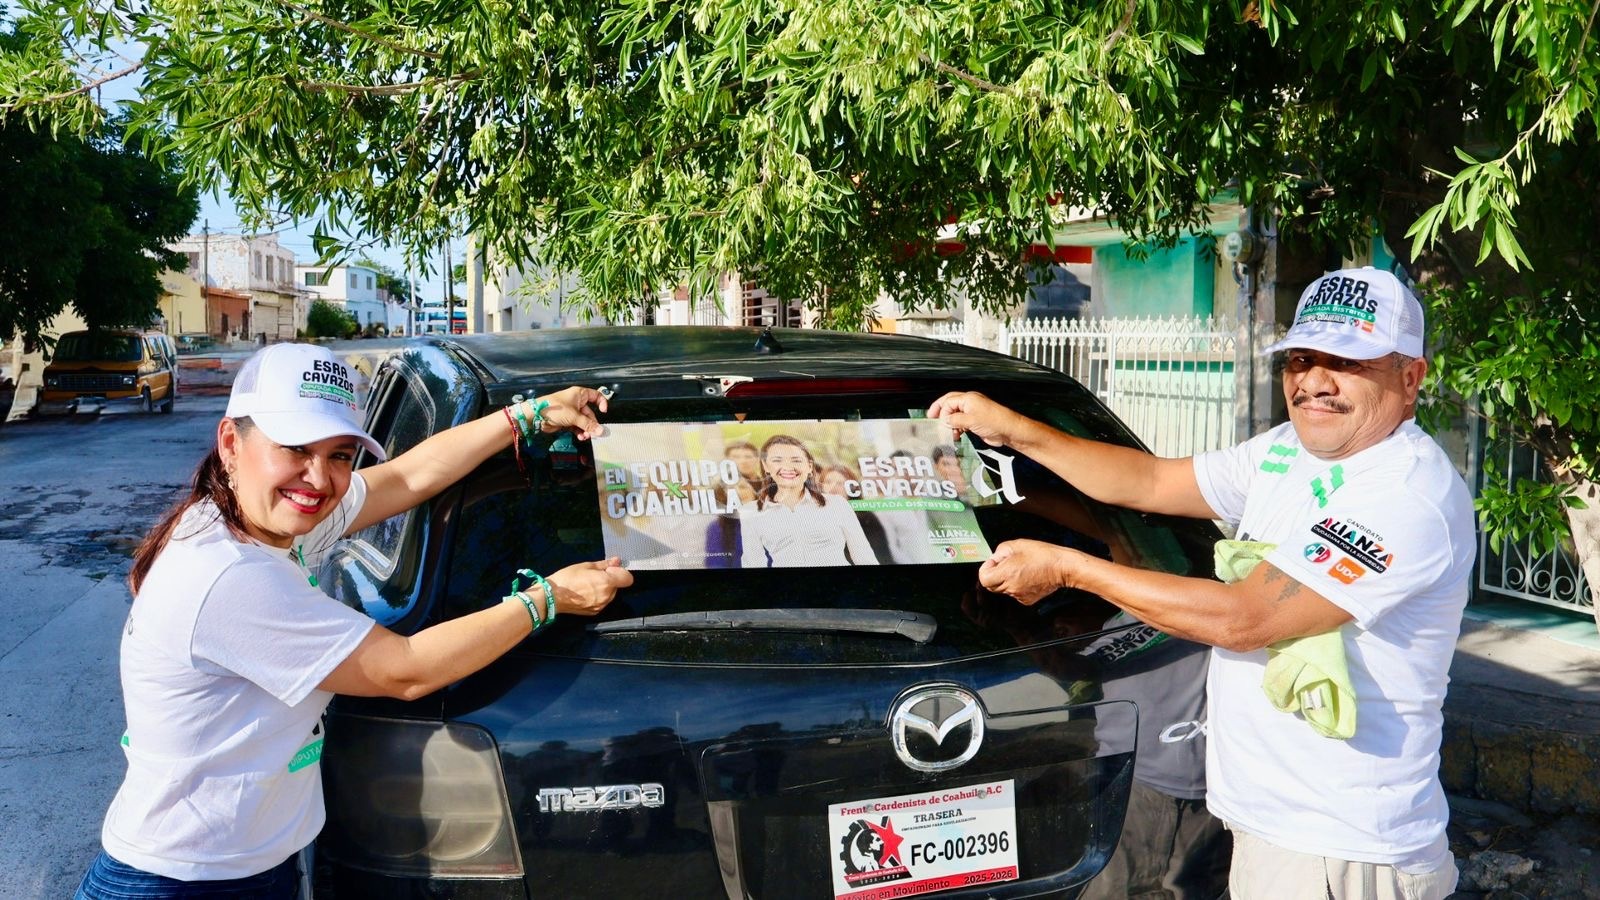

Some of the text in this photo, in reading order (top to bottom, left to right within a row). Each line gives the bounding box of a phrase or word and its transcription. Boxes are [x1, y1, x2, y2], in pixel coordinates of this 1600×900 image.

[1318, 276, 1370, 297] ESRA
[1304, 292, 1378, 314] CAVAZOS
[313, 360, 348, 379] ESRA
[303, 371, 354, 394] CAVAZOS
[605, 459, 741, 490] EN EQUIPO
[858, 455, 935, 478] ESRA
[844, 478, 959, 499] CAVAZOS
[607, 488, 743, 519] COAHUILA
[852, 500, 903, 510] DIPUTADA
[905, 500, 950, 510] DISTRITO
[928, 529, 978, 538] ALIANZA
[1346, 518, 1384, 542] CANDIDATO
[1313, 525, 1384, 572] CIUDADANA POR LA SEGURIDAD
[1319, 517, 1394, 568] ALIANZA
[841, 804, 874, 816] Frent
[874, 800, 926, 811] Cardenista
[929, 796, 940, 804] de
[986, 785, 1002, 795] A.C
[914, 809, 963, 823] TRASERA
[911, 831, 1010, 866] FC-002396
[879, 887, 891, 899] en
[893, 880, 950, 896] Movimiento
[964, 870, 1013, 886] 2025-2026
